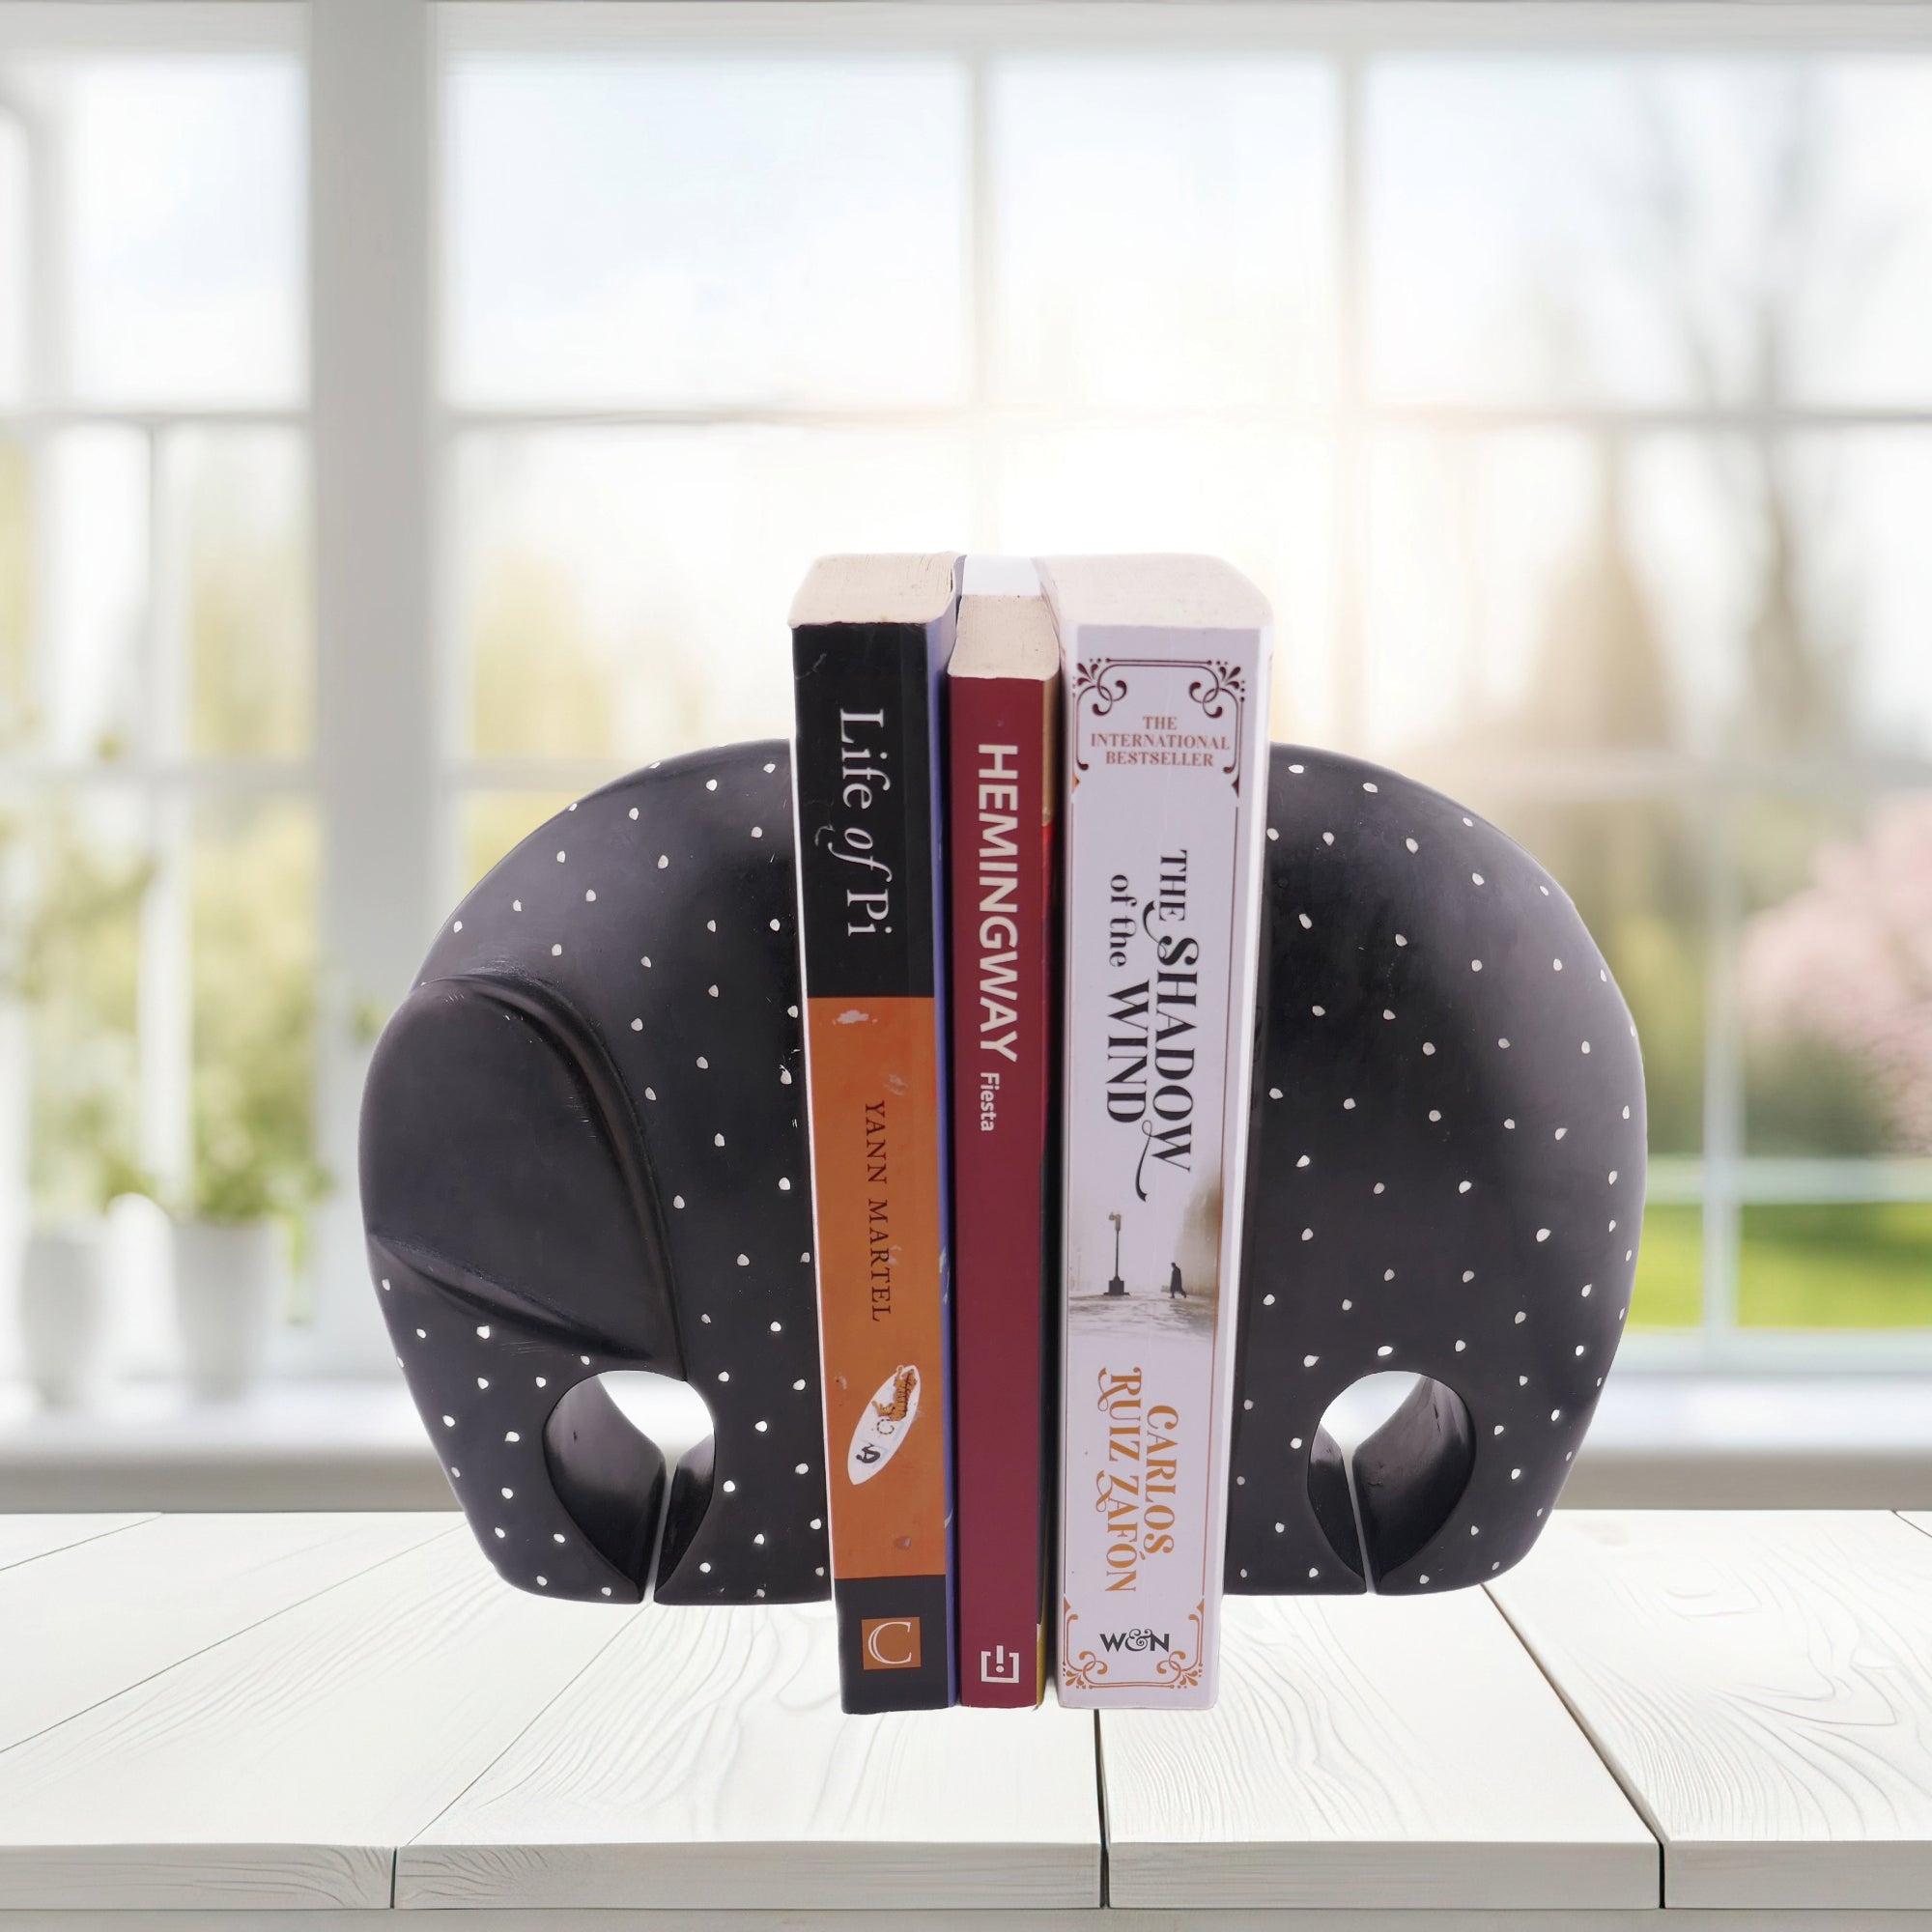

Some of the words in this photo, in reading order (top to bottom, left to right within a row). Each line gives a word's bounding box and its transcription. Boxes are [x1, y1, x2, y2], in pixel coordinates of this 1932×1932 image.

[839, 708, 891, 810] Life
[1091, 733, 1230, 750] INTERNATIONAL
[1105, 751, 1214, 767] BESTSELLER
[1143, 716, 1178, 730] THE
[828, 827, 893, 883] of
[1110, 874, 1137, 907] of
[1159, 849, 1187, 922] THE
[846, 889, 893, 937] Pi
[978, 744, 1019, 1063] HEMINGWAY
[1109, 917, 1137, 967] the
[1105, 979, 1150, 1123] WIND
[1135, 900, 1200, 1202] SHADOW
[980, 1071, 1000, 1131] Fiesta
[865, 1099, 888, 1184] YANN
[868, 1198, 892, 1321] MARTEL
[1097, 1367, 1142, 1462] RUIZ
[1143, 1405, 1179, 1553] CARLOS
[1095, 1469, 1146, 1592] ZAFÓN
[1099, 1628, 1170, 1653] W&N
